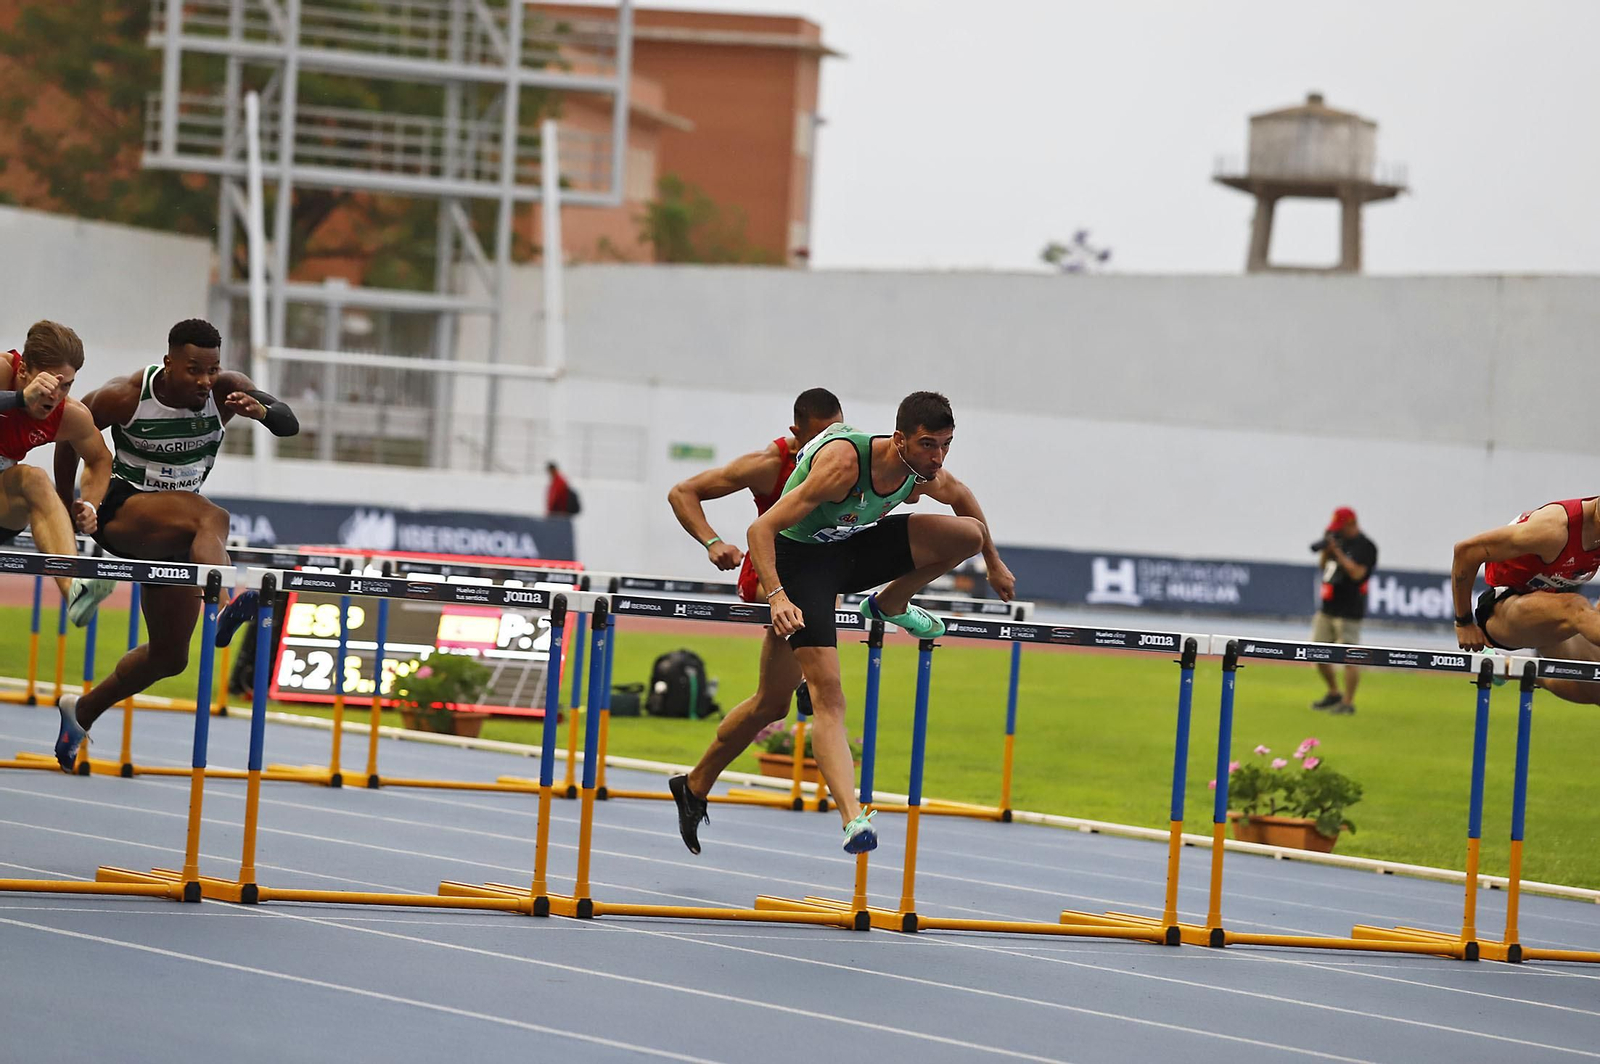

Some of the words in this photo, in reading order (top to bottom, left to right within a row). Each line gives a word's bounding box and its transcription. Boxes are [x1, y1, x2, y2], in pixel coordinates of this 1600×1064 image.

[400, 523, 539, 559] IBERDROLA
[303, 580, 336, 588] IBERDROLA
[1166, 582, 1240, 604] HUELVA
[1368, 574, 1454, 618] Huel
[630, 603, 662, 611] IBERDROLA
[835, 613, 859, 624] ma
[1255, 647, 1284, 655] IBERDROLA
